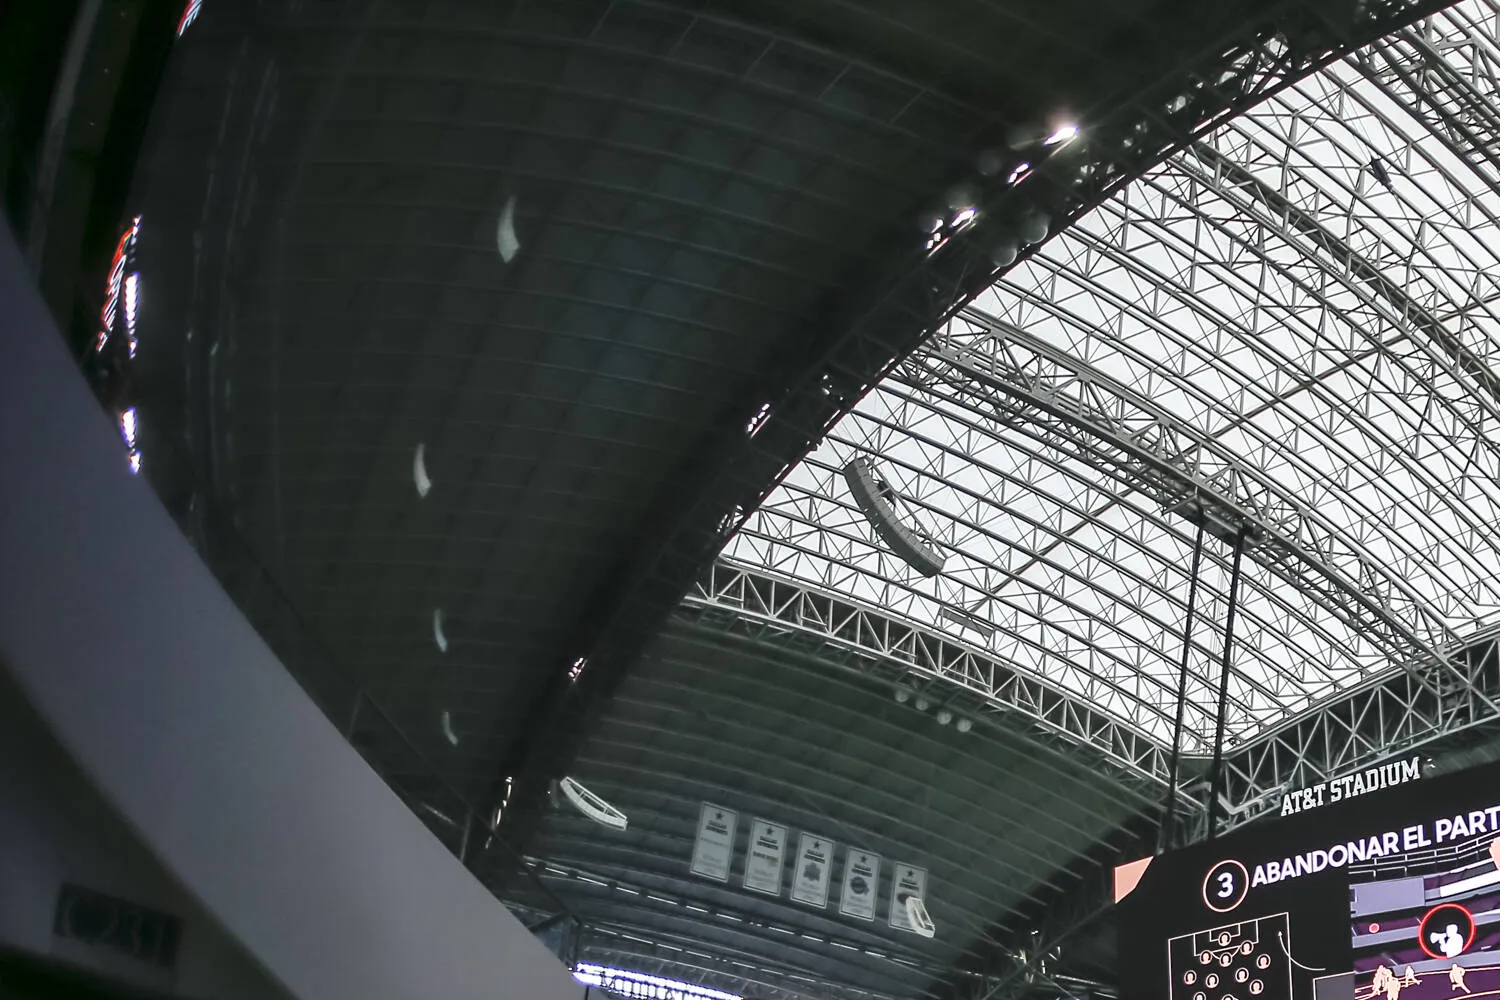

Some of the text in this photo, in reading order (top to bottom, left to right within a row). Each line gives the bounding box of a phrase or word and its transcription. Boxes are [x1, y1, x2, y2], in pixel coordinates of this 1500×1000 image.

[1280, 756, 1421, 817] AT&T STADIUM
[1216, 872, 1234, 898] 3
[1251, 832, 1400, 888] ABANDONAR
[1404, 823, 1432, 849] EL
